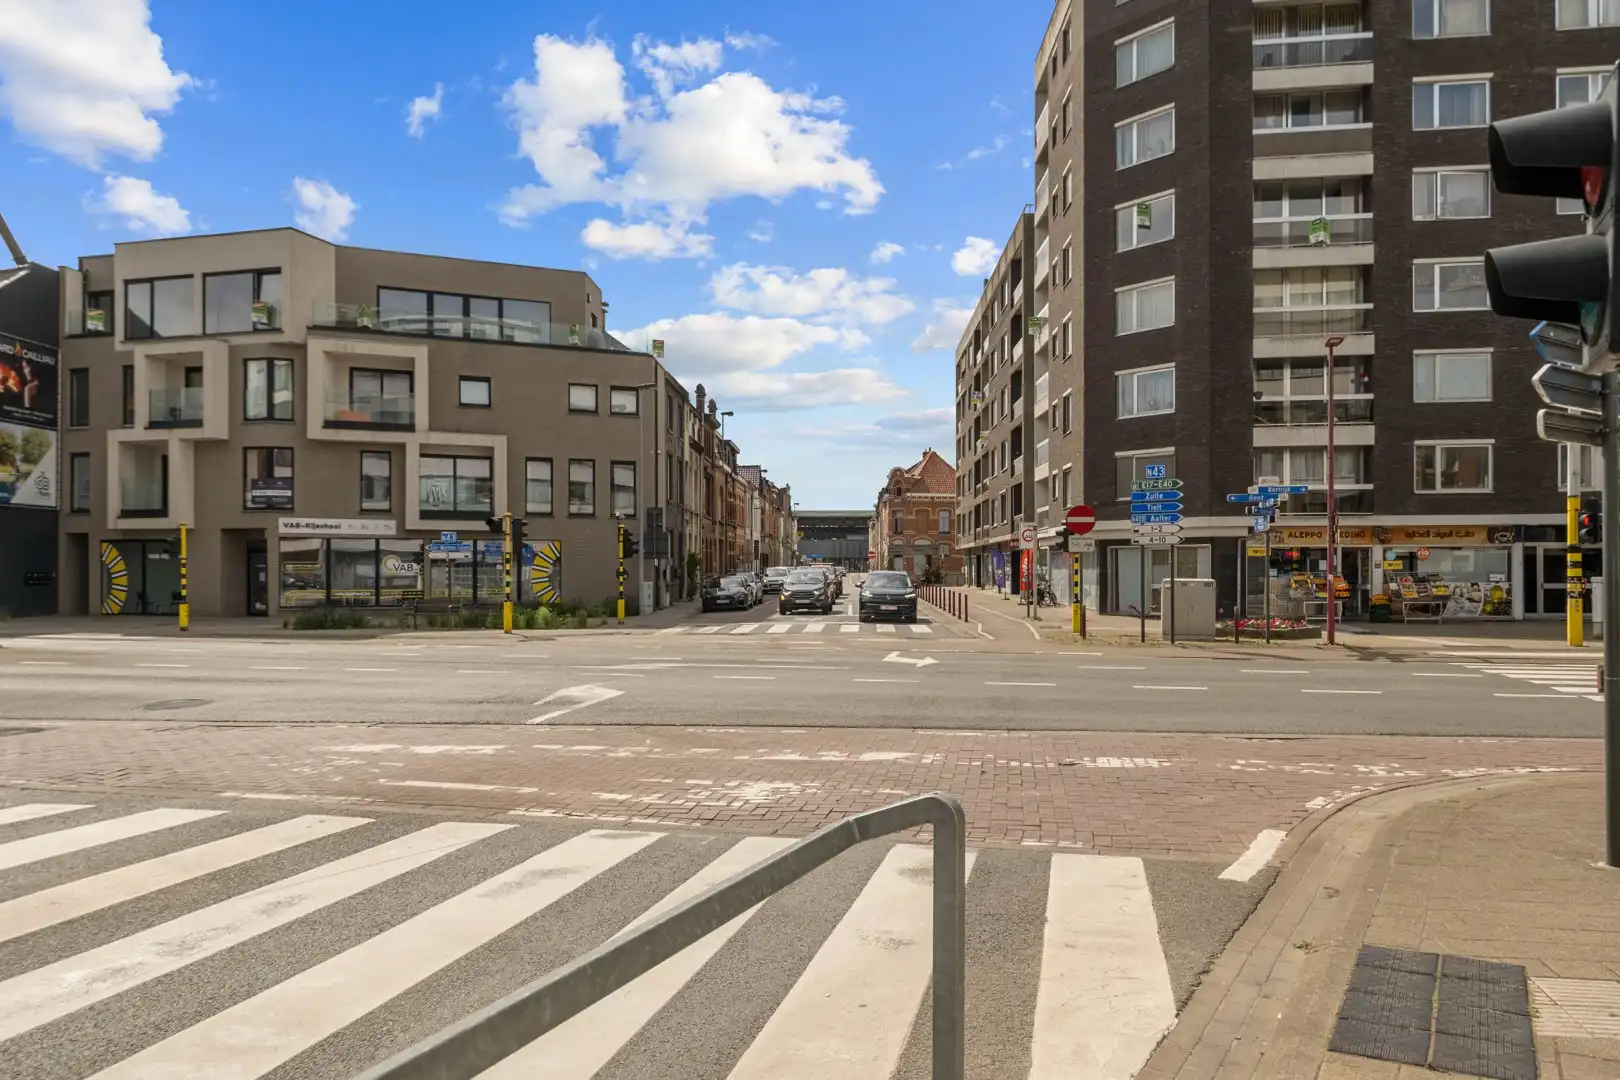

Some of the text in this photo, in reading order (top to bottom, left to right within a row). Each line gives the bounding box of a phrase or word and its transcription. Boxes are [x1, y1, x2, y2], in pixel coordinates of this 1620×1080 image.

[1147, 466, 1165, 477] N43
[1141, 480, 1173, 489] E17-E40
[1267, 486, 1292, 494] Kortrijk
[282, 522, 342, 530] VAB-Rijschool
[1287, 531, 1322, 539] ALEPPO
[393, 563, 414, 572] VAB
